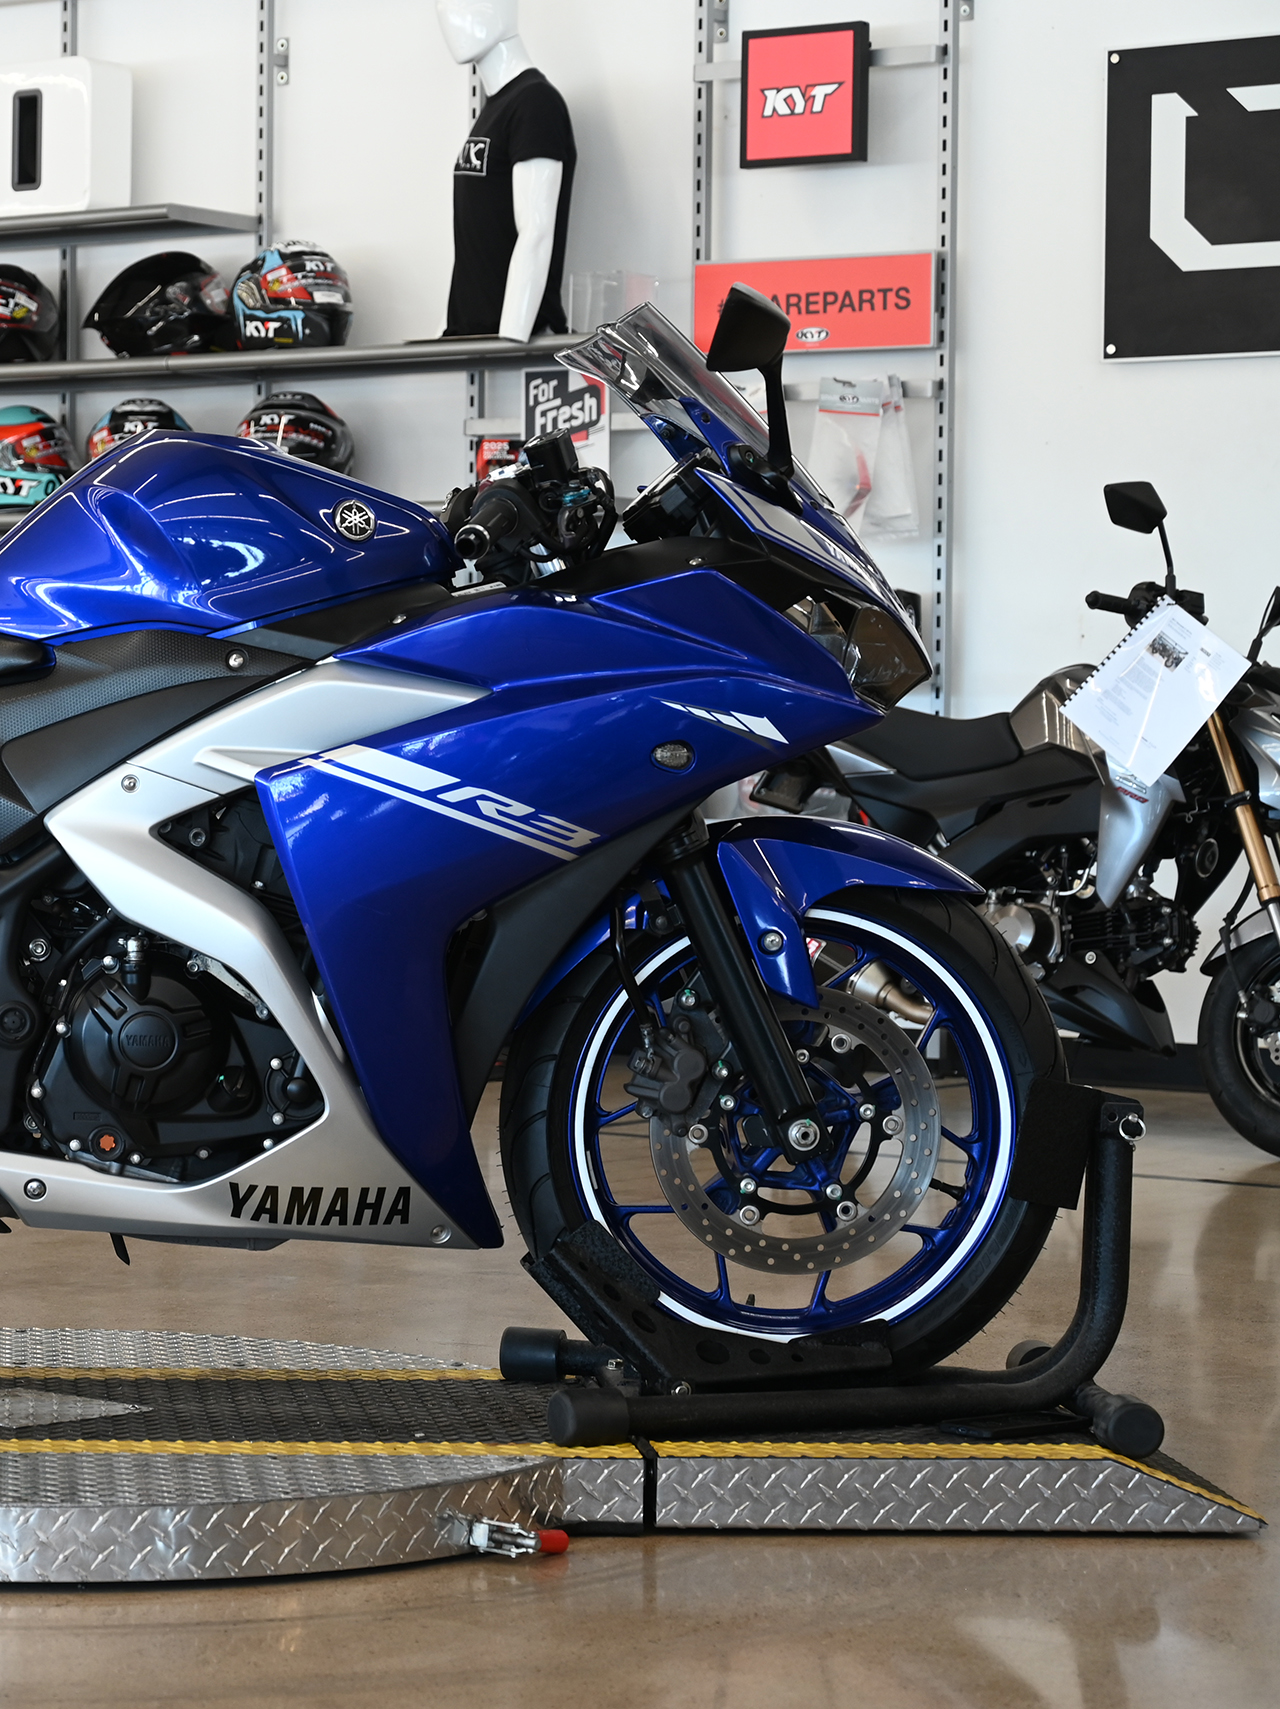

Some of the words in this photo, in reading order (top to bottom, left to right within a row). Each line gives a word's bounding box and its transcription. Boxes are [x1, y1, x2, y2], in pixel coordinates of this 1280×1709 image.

[760, 81, 845, 118] KYT
[245, 321, 282, 338] KYT
[529, 377, 558, 407] For
[535, 392, 598, 436] Fresh
[436, 786, 601, 848] R3
[125, 1034, 171, 1047] YAMAHA
[228, 1181, 412, 1226] YAMAHA
